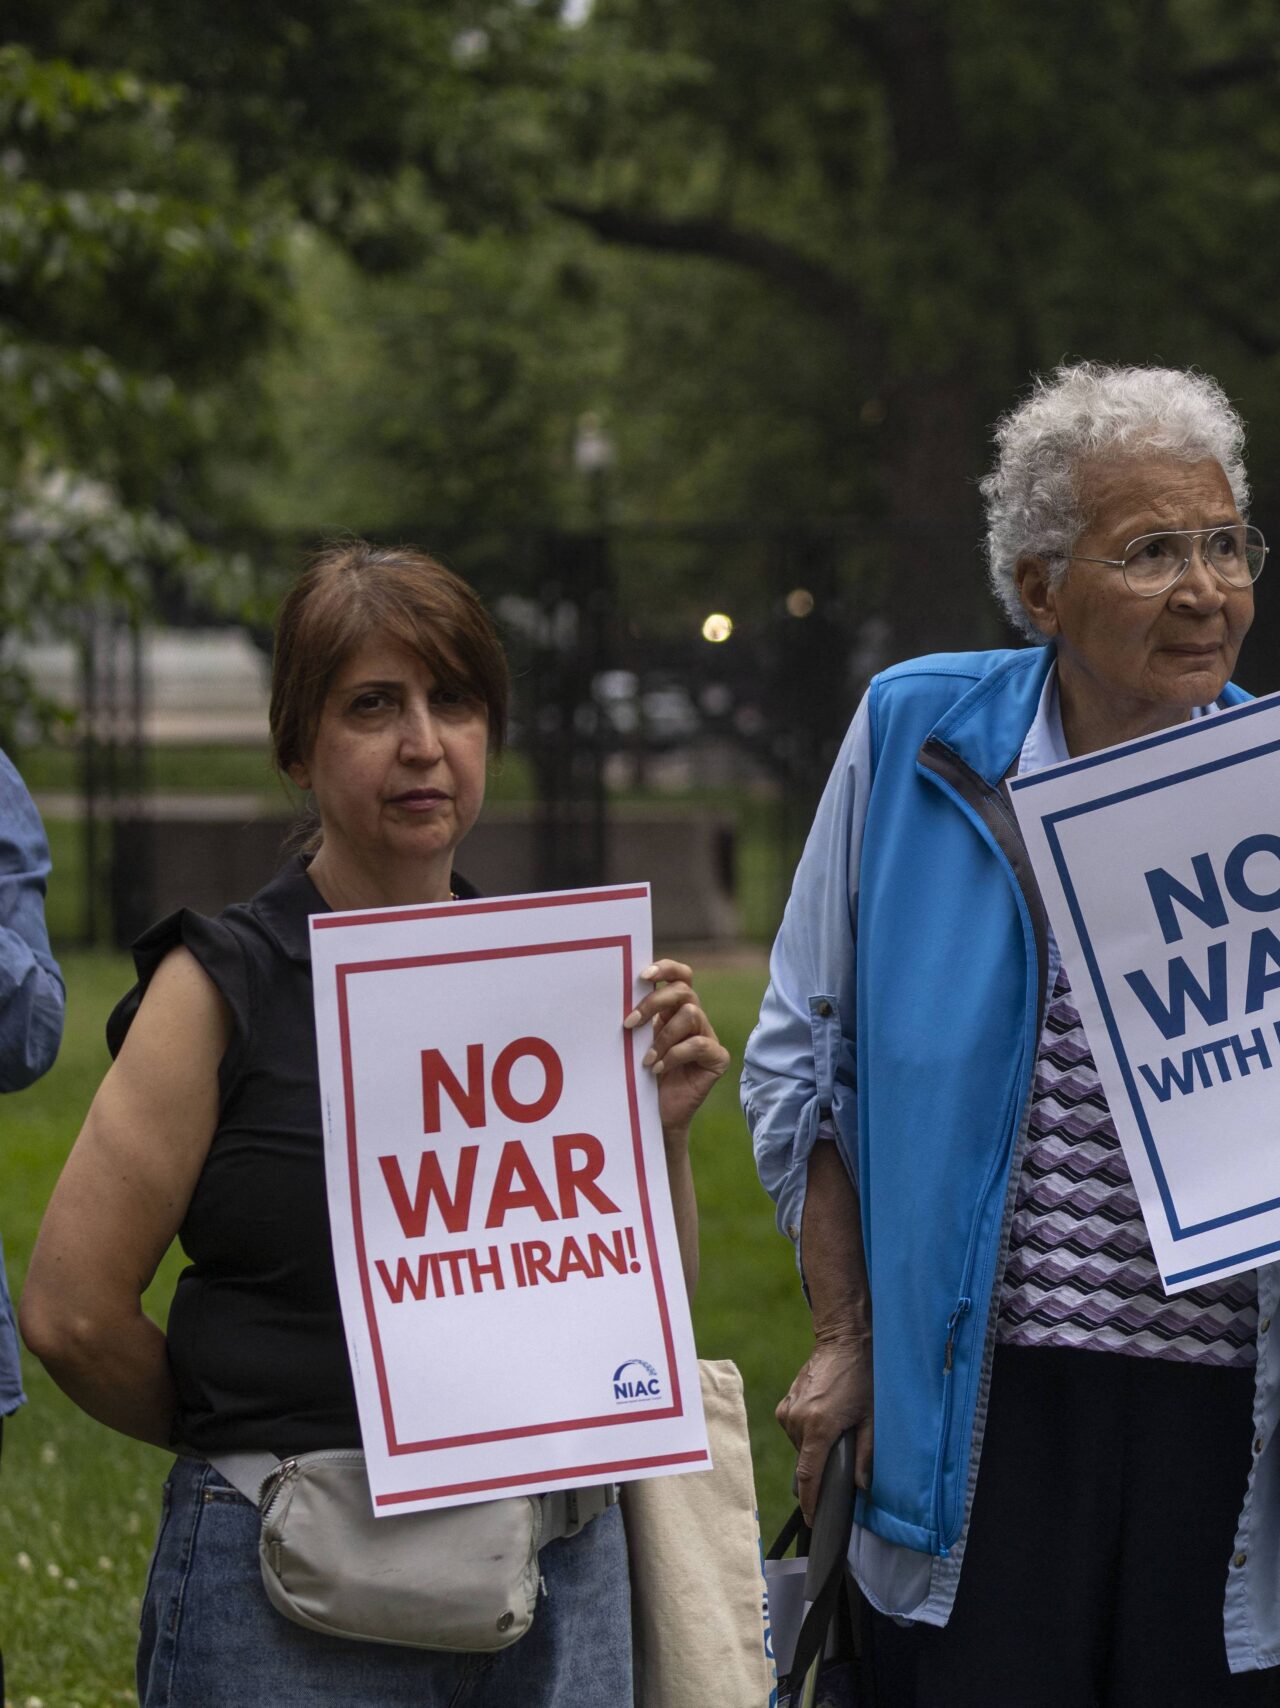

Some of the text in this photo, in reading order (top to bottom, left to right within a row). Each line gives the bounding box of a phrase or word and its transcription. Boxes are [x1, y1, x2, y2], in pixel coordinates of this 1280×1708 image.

[421, 1036, 564, 1134] NO
[1138, 1026, 1273, 1103] WITH
[377, 1132, 622, 1239] WAR
[374, 1226, 643, 1304] WITH IRAN!
[613, 1378, 661, 1400] NIAC
